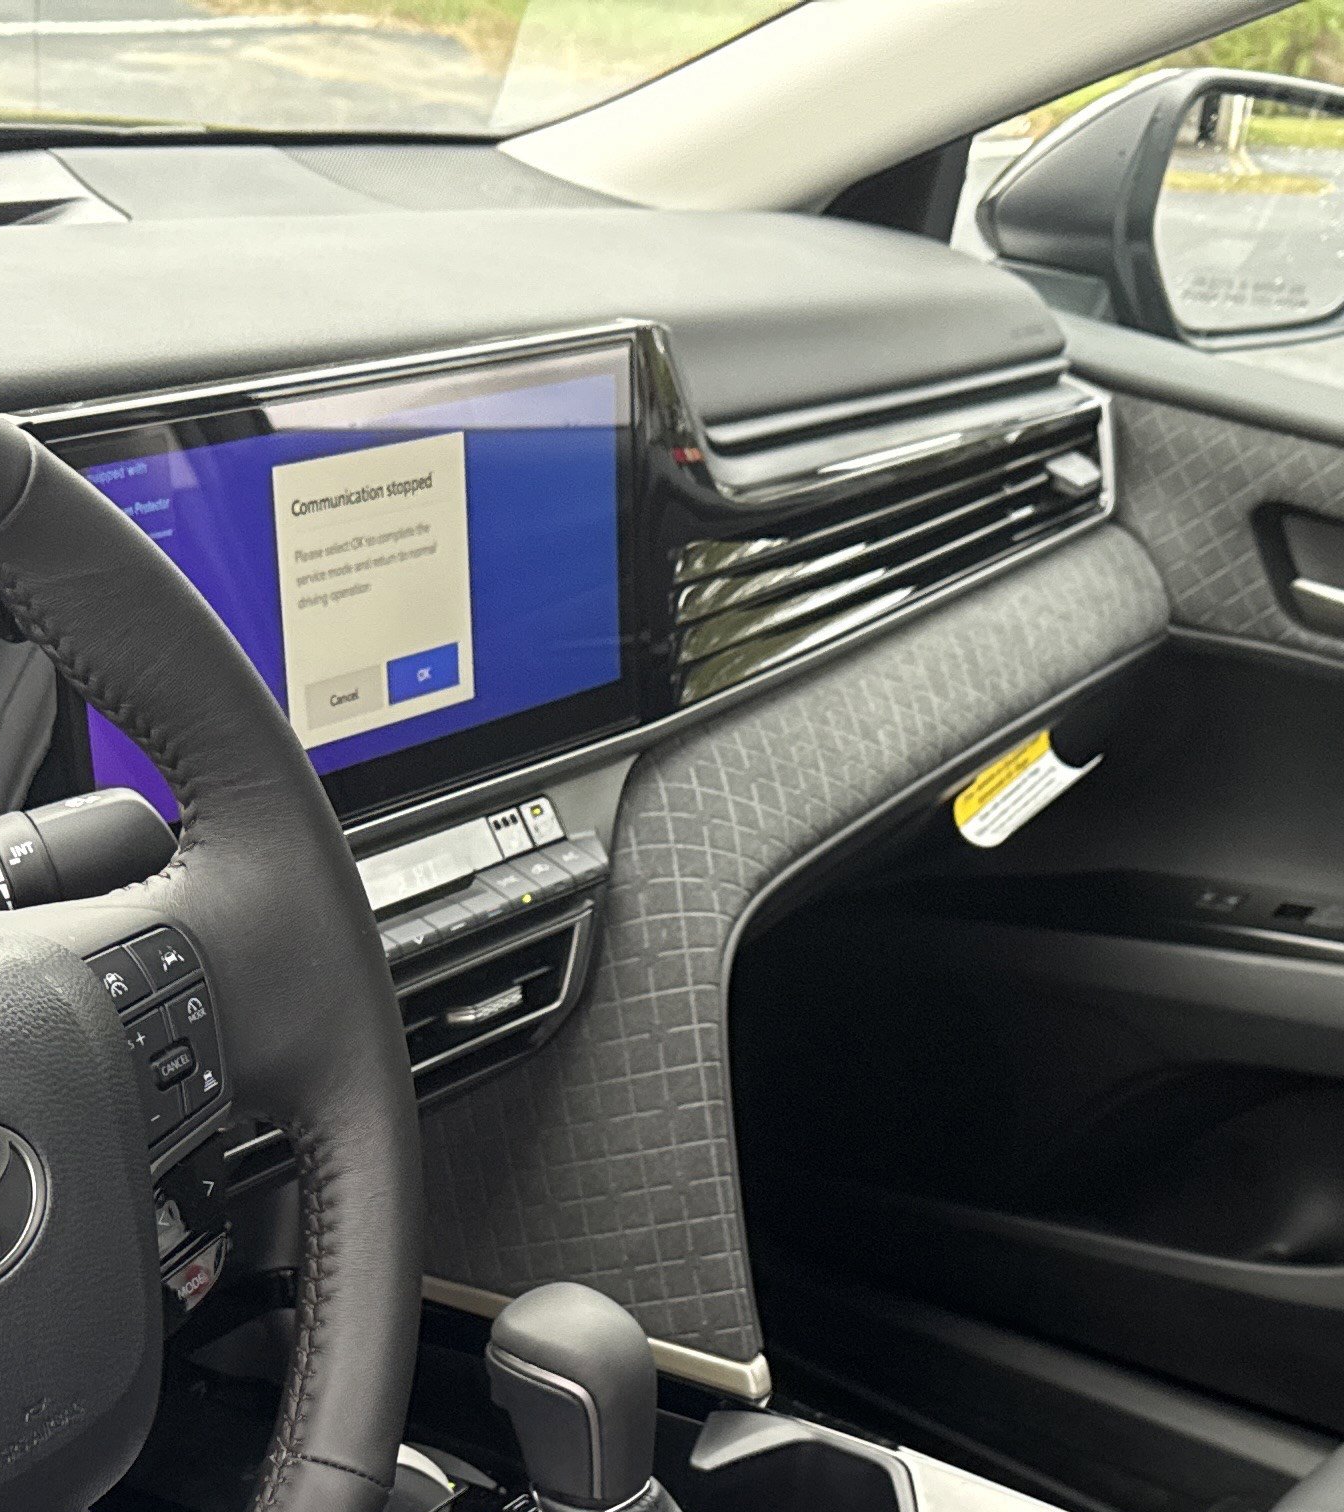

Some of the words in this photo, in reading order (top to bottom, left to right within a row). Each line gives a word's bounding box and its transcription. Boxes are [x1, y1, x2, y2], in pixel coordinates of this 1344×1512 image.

[291, 484, 385, 518] Communication
[386, 472, 433, 499] stopped
[329, 688, 360, 707] Cancel
[9, 841, 34, 858] INT
